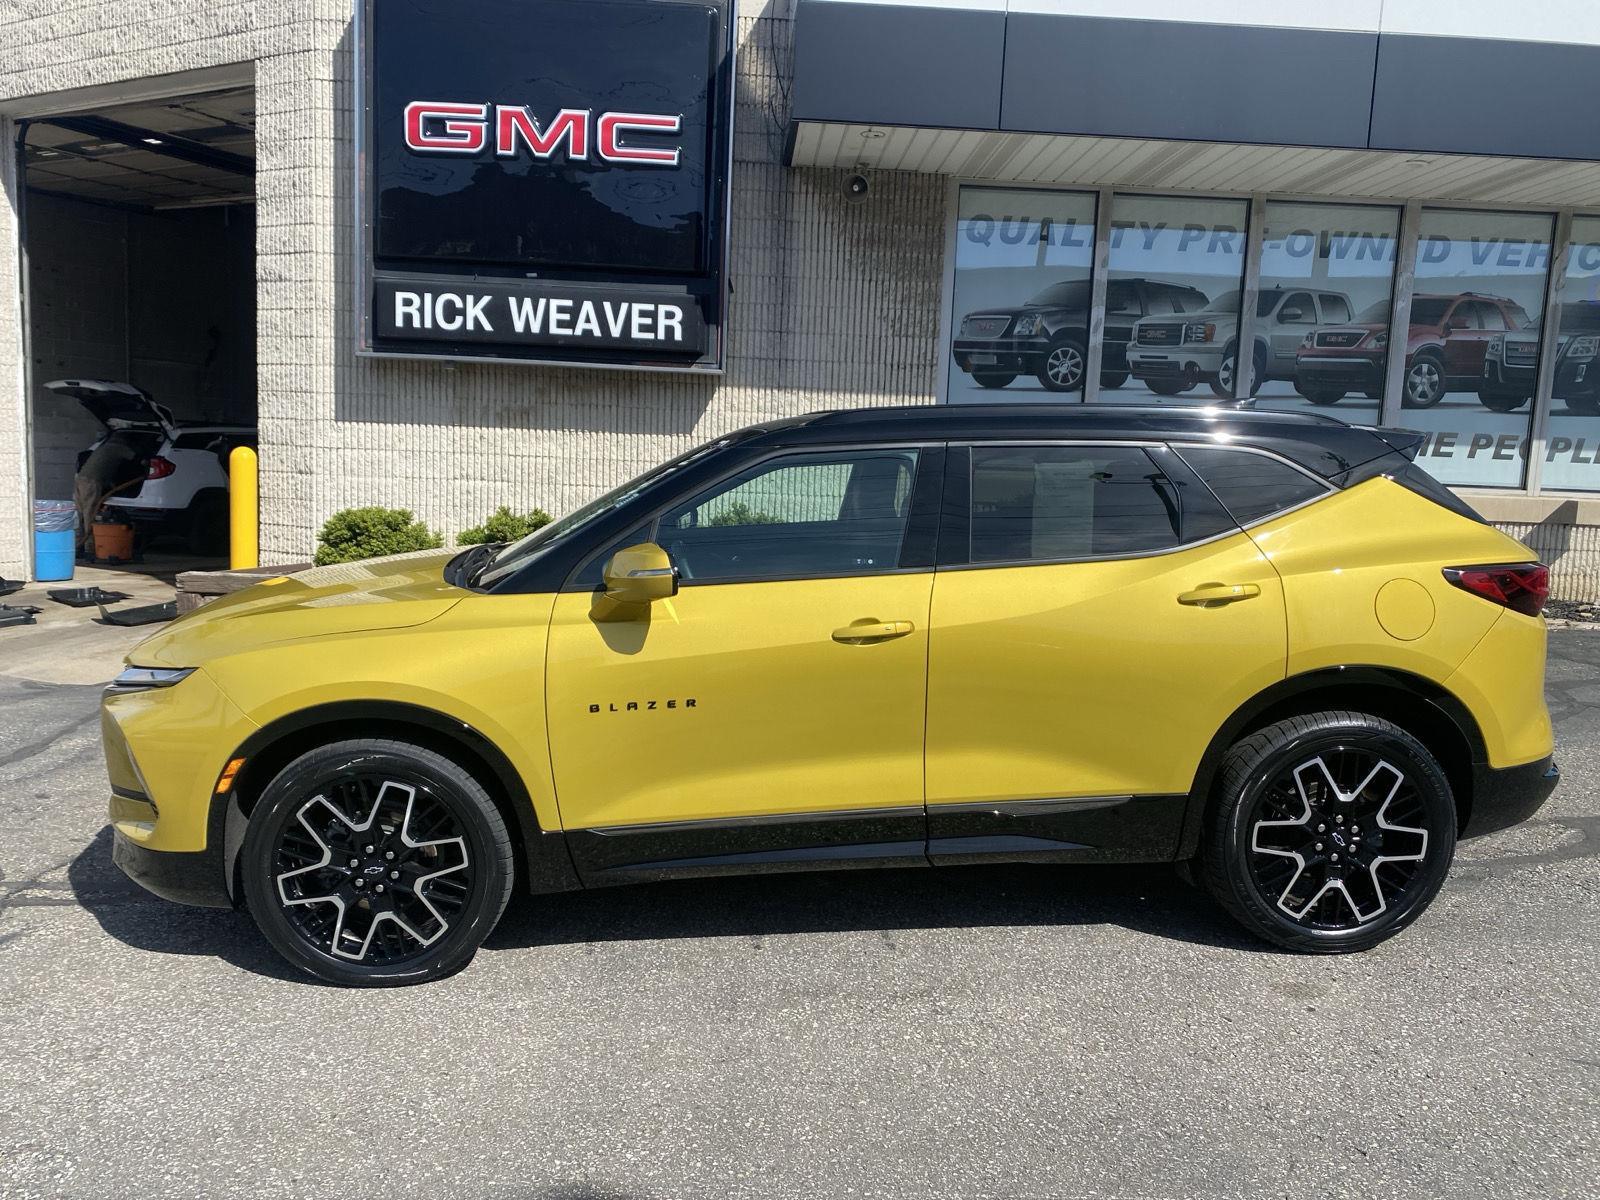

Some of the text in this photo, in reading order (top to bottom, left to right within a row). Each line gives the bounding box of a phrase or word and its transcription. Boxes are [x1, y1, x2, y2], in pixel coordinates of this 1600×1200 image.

[404, 101, 682, 166] GMC
[966, 213, 1168, 251] QUALTY
[394, 291, 684, 342] RICK WEAVER
[1467, 433, 1600, 465] PEPL
[589, 698, 697, 713] BLAZER
